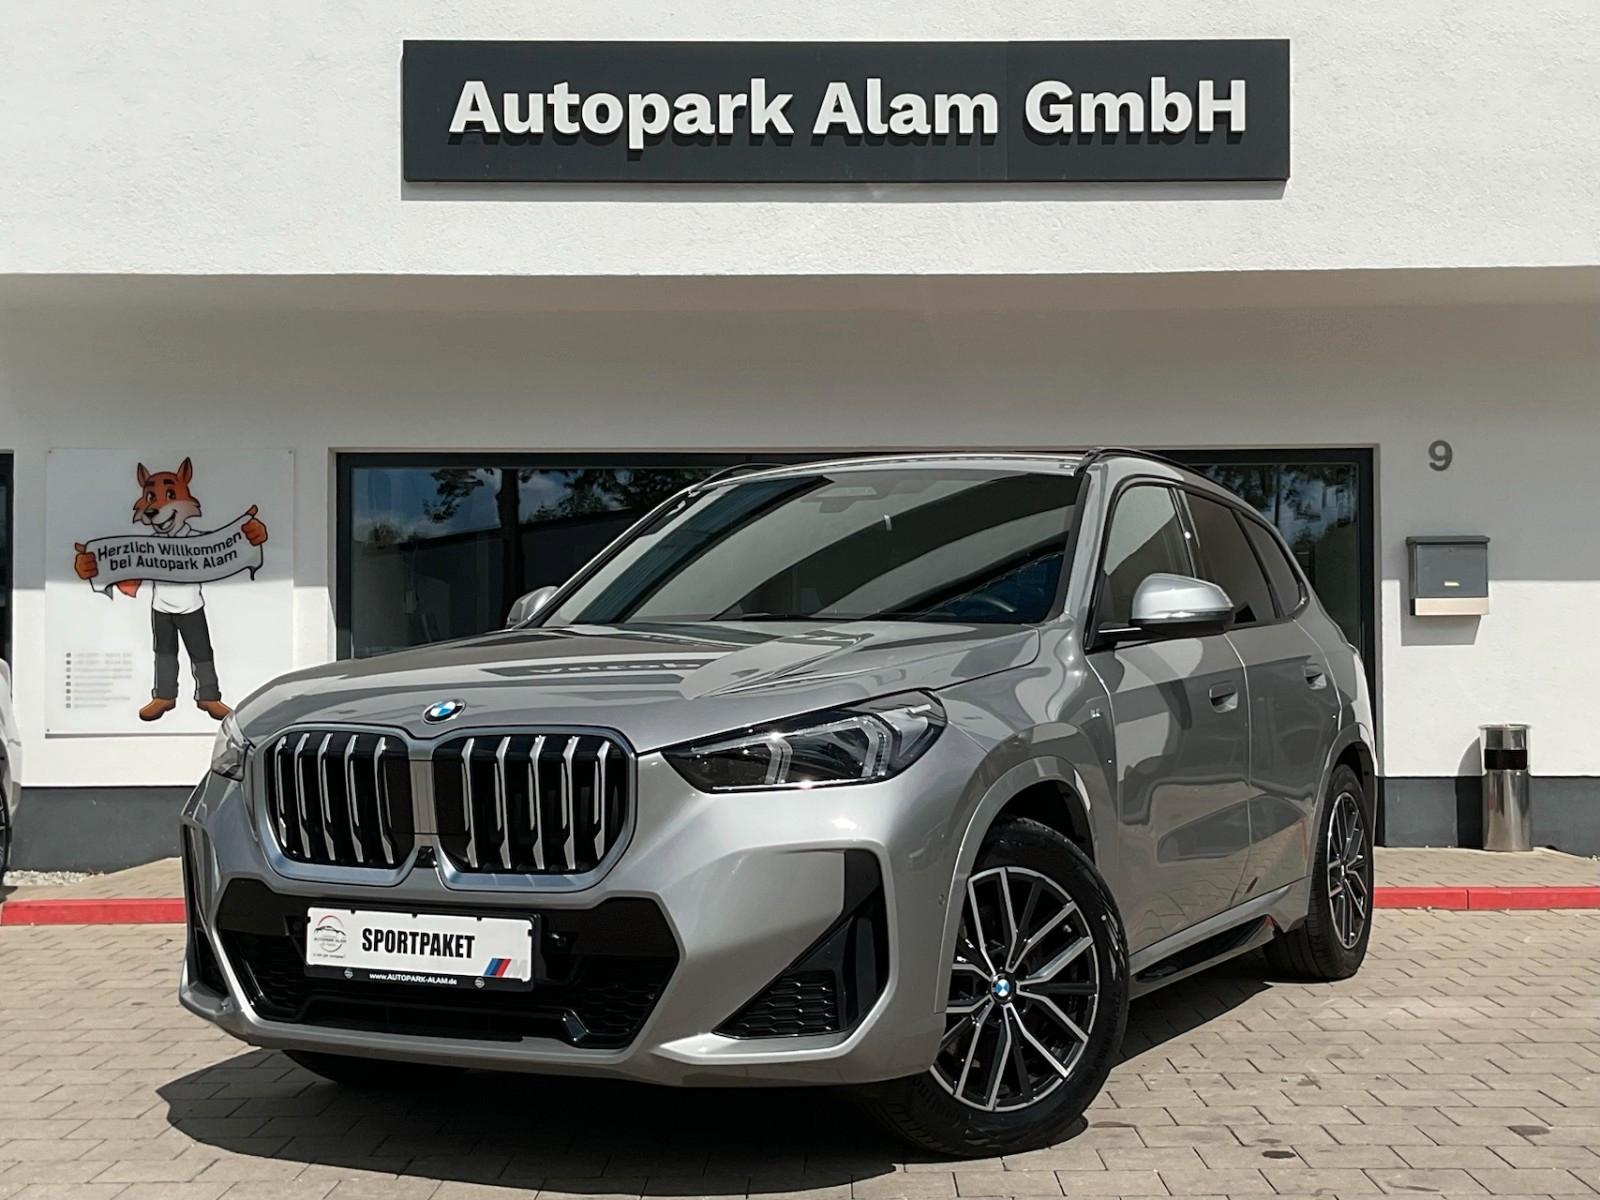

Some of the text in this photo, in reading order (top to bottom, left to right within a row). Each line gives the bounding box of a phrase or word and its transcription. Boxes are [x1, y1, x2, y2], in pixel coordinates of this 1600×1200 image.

[448, 76, 1246, 150] Autopark Alam GmbH
[1428, 440, 1453, 471] 9
[98, 532, 242, 561] Herzlich Willkommen
[110, 550, 238, 571] bei Autopark Alam
[362, 928, 475, 958] SPORTPAKET
[369, 973, 457, 985] www.AUTOPARK-ALAM.de
